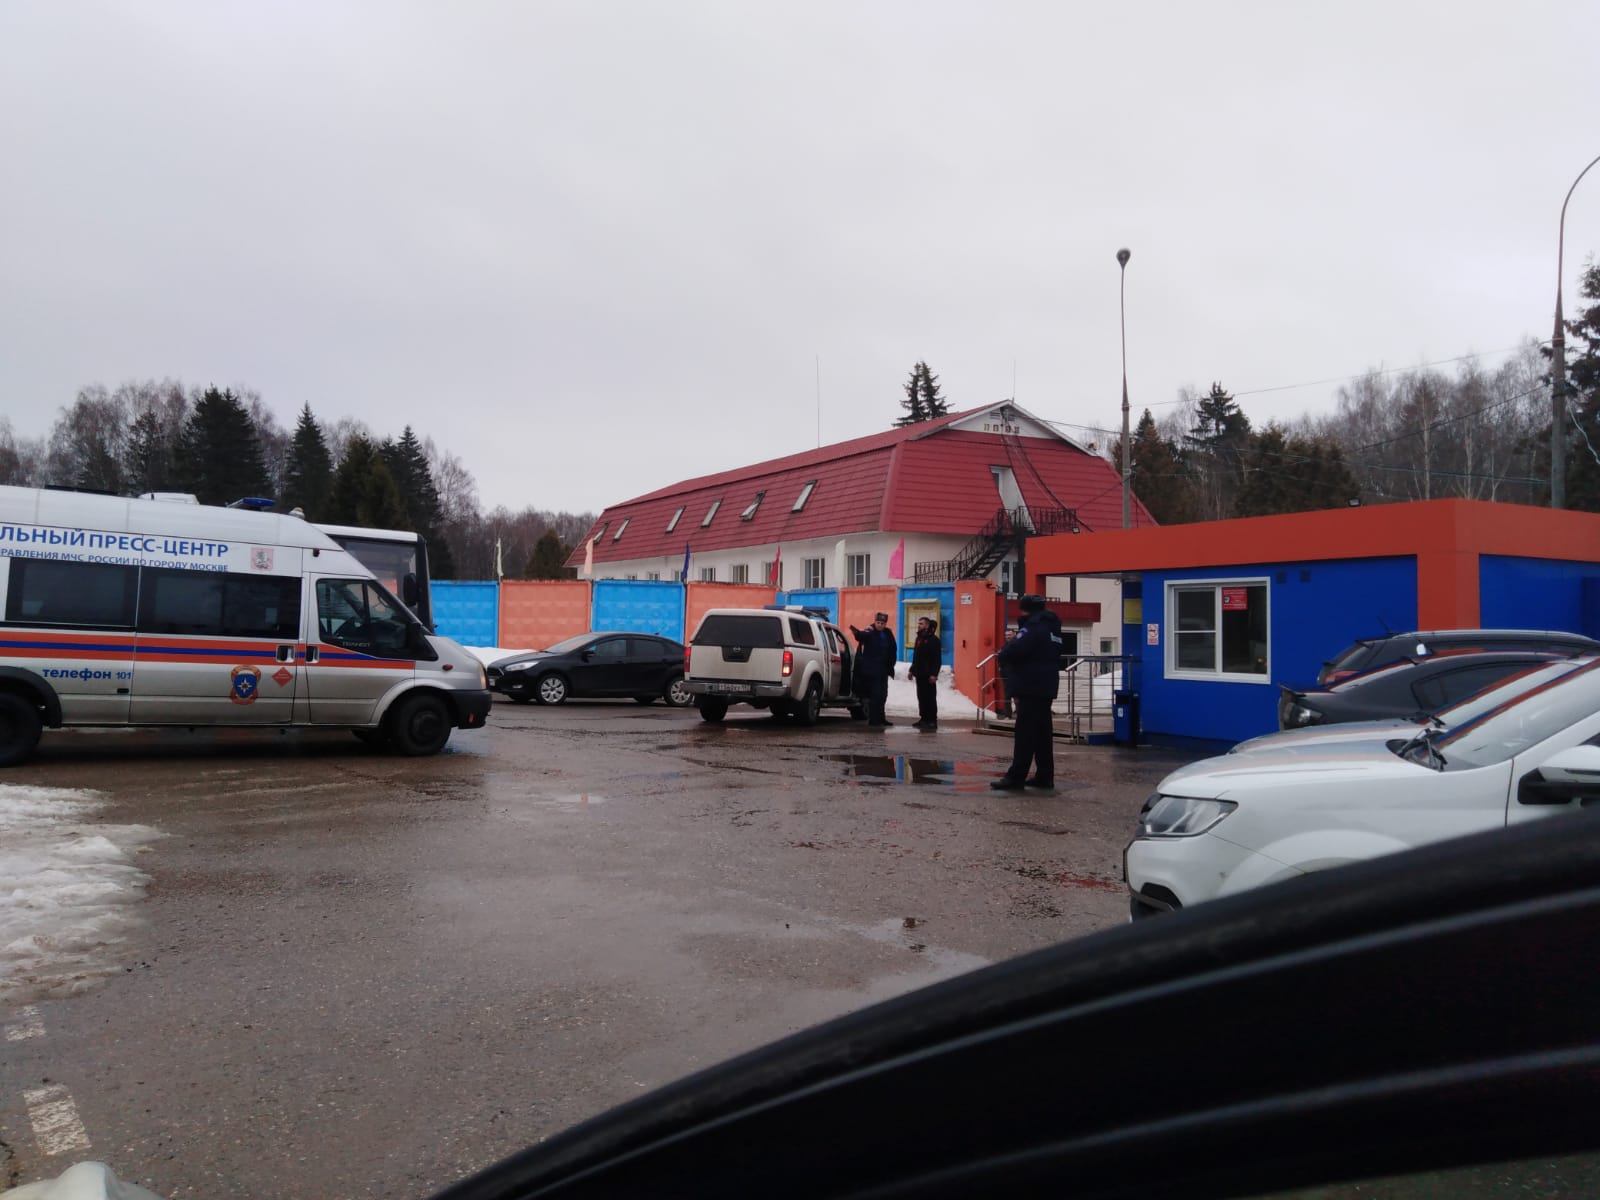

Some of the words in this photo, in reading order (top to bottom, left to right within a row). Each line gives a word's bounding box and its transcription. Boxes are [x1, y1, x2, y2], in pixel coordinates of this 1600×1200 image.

[0, 526, 85, 547] ЛЬНЫЙ
[89, 533, 229, 557] ПРЕСС-ЦЕНТР
[61, 552, 84, 562] МЧС
[87, 554, 130, 565] РОССИИ
[132, 557, 147, 566] ПО
[149, 559, 188, 569] ГОРОДУ
[189, 562, 229, 573] МОСКВЕ
[42, 668, 112, 682] телефон
[115, 671, 132, 680] 101
